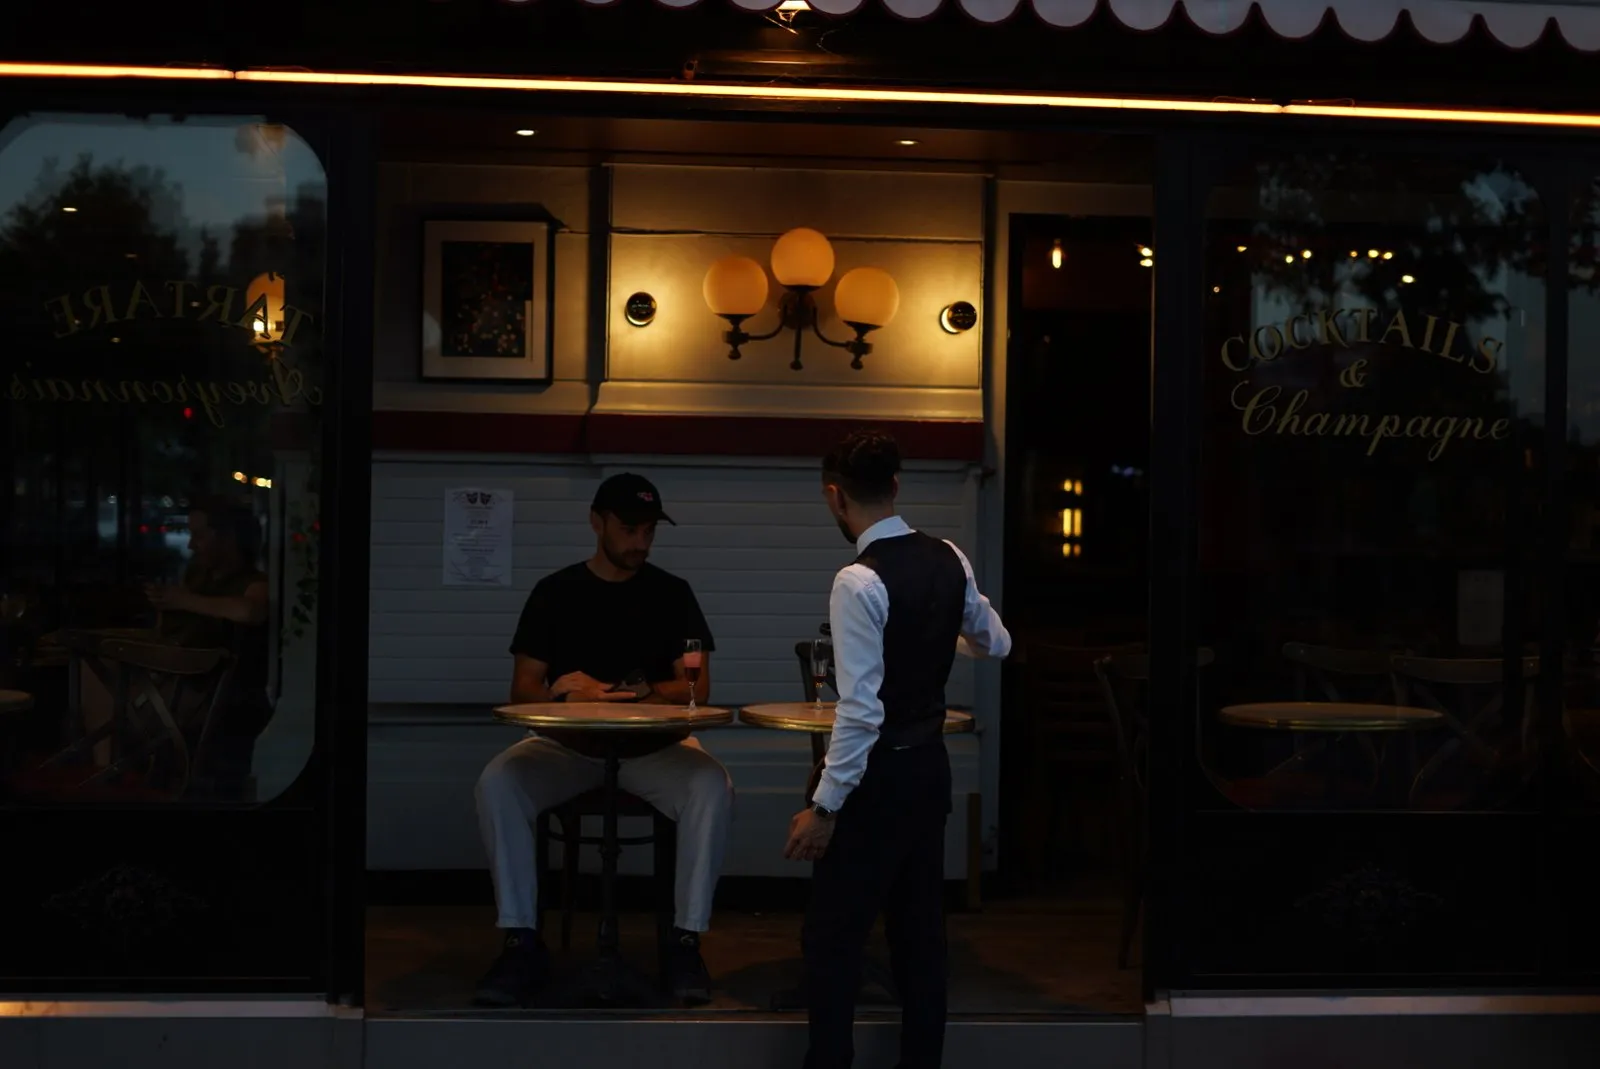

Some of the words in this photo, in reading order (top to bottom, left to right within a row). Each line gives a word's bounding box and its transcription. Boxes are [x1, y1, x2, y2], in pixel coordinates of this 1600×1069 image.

[1220, 308, 1503, 375] COCKTAILS
[1339, 358, 1369, 389] &
[1230, 379, 1512, 462] Champagne
